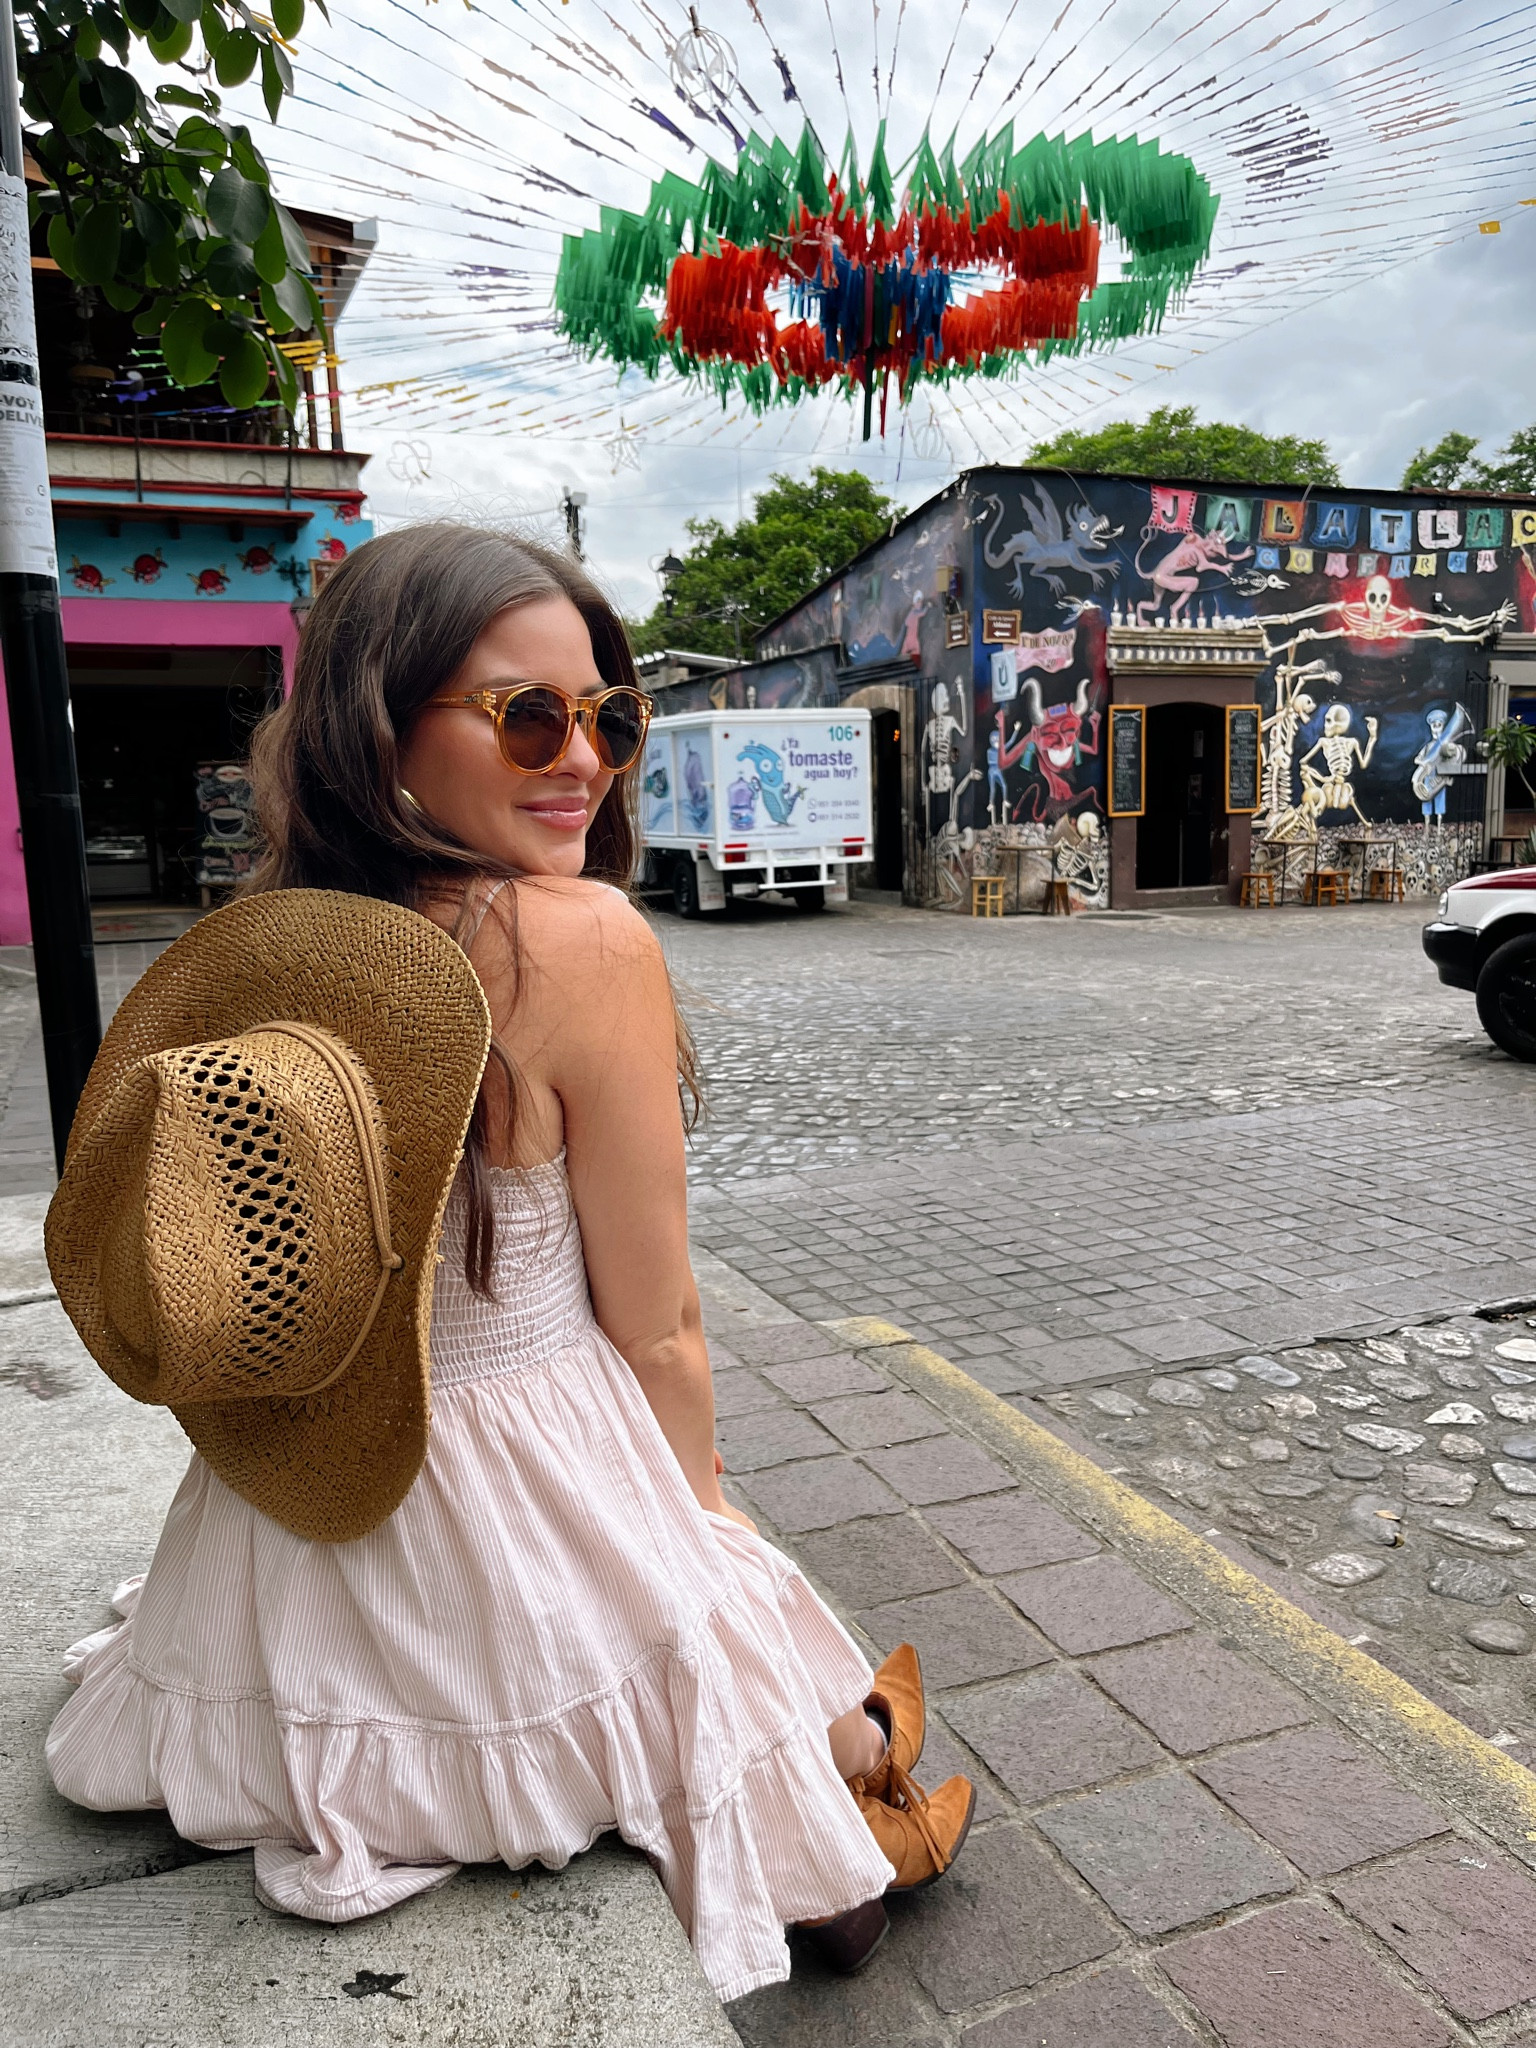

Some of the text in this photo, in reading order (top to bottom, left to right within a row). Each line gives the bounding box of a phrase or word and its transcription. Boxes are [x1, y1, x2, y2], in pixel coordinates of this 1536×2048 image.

[1260, 551, 1492, 573] COMPARSA
[828, 725, 853, 741] 106
[781, 738, 799, 751] ¿Ya
[789, 750, 853, 767] tomaste
[804, 766, 858, 781] agua hoy?
